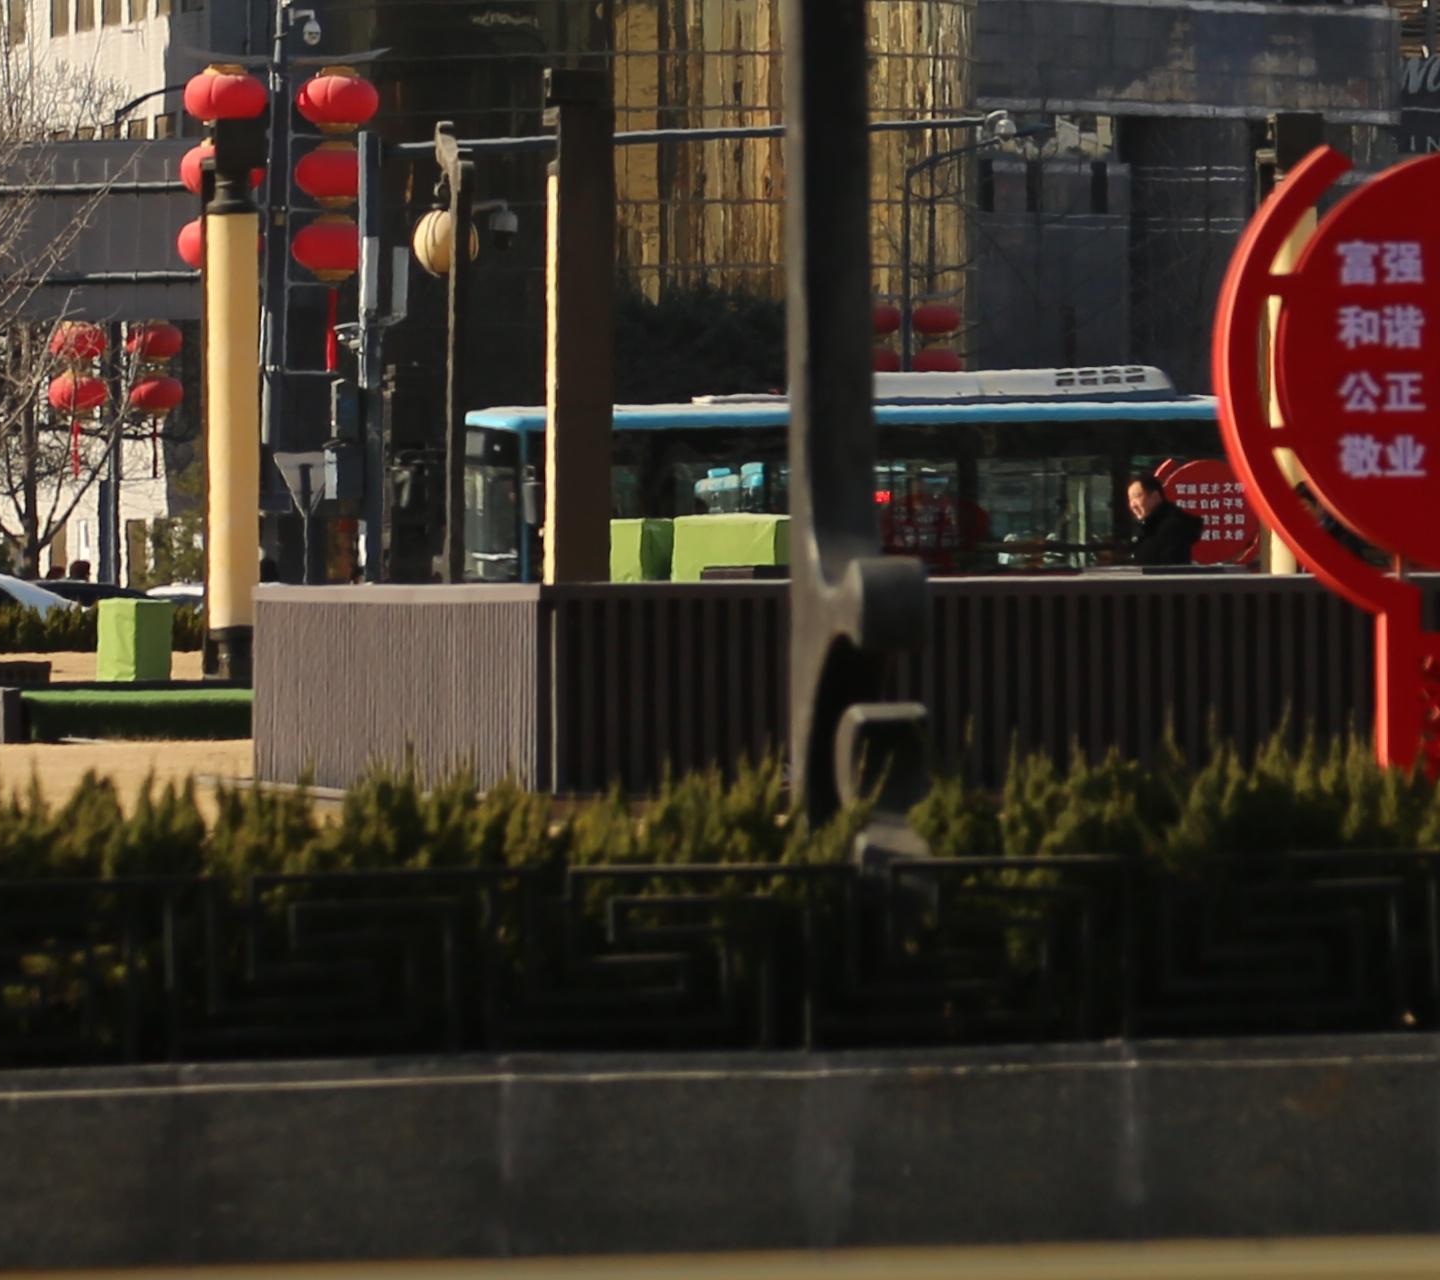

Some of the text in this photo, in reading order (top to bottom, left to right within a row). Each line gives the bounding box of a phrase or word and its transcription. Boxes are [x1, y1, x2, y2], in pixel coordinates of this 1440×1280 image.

[1336, 240, 1424, 286] 富强
[1338, 306, 1425, 349] 和谐
[1338, 370, 1427, 414] 公正
[1338, 434, 1427, 479] 敬业
